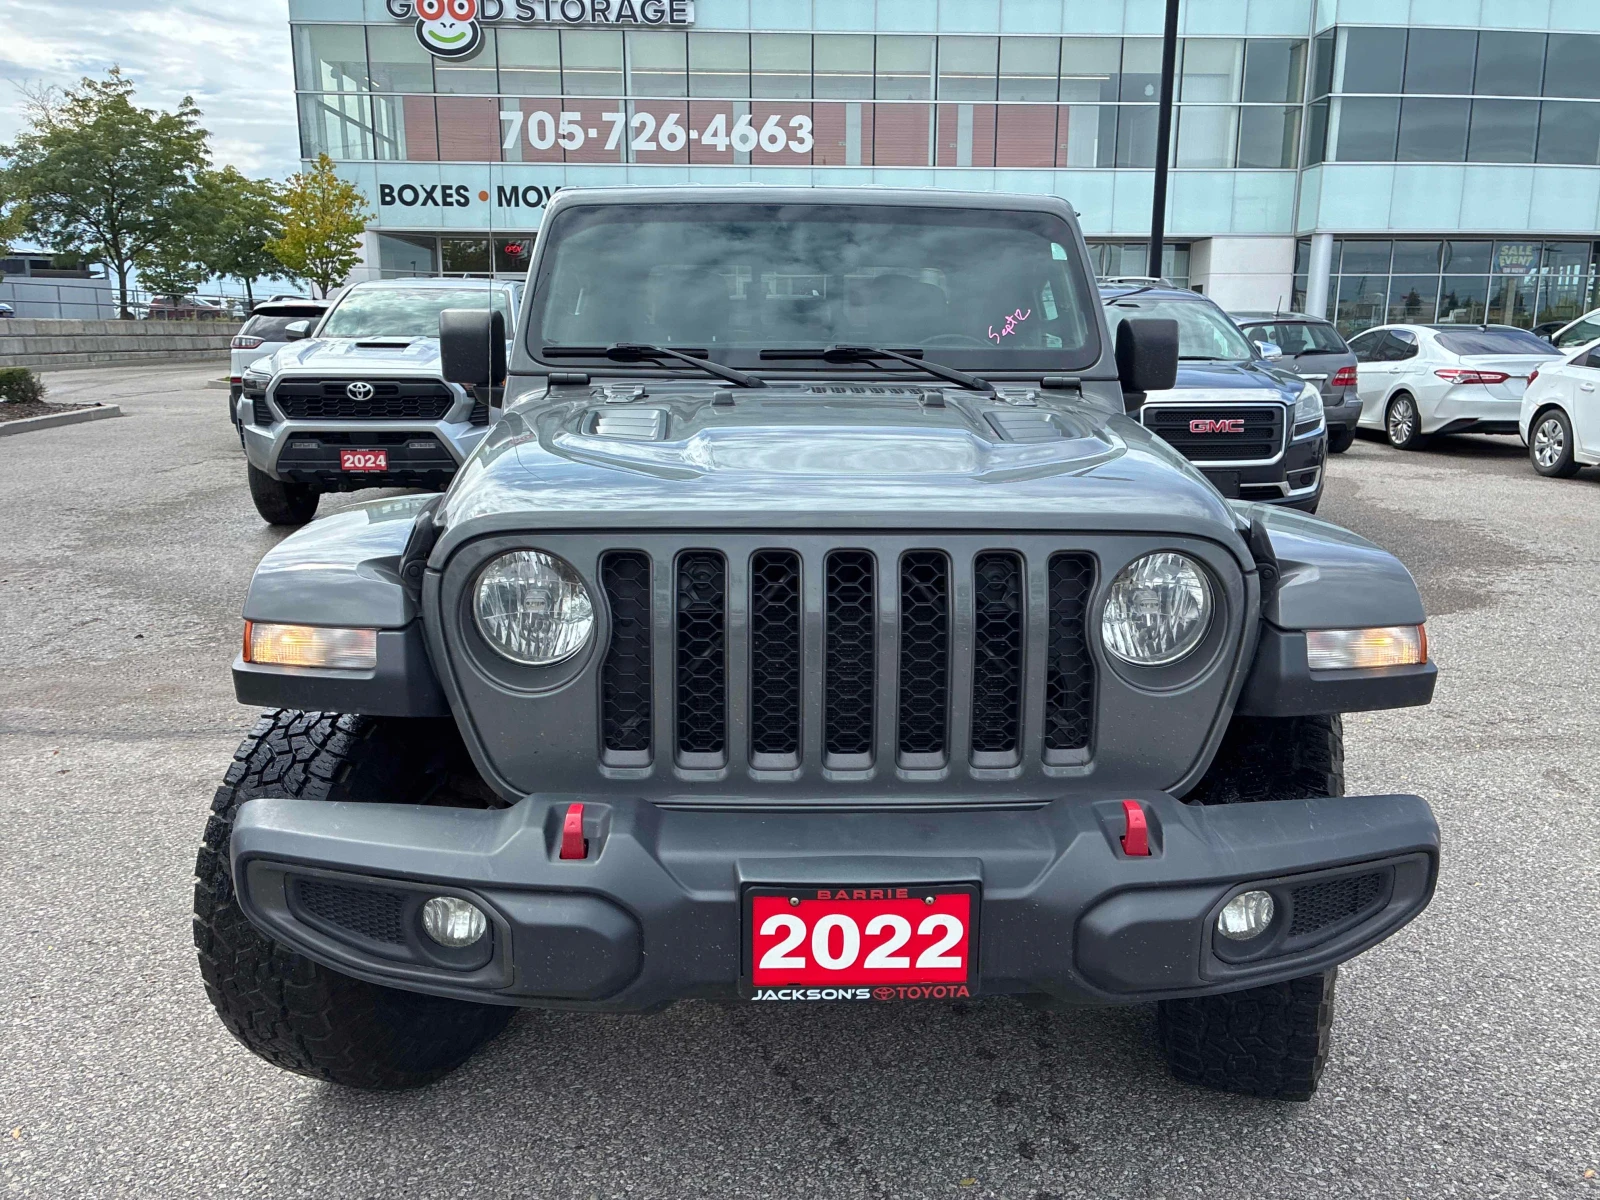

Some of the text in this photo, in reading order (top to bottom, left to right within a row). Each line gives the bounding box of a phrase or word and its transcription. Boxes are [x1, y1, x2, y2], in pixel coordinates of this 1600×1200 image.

[386, 0, 688, 24] GOOD STORAGE
[379, 184, 470, 207] BOXES
[1500, 245, 1532, 255] SALE
[1499, 255, 1533, 267] EVENT
[1189, 419, 1245, 433] GMC
[343, 454, 387, 467] 2024
[817, 889, 909, 900] BARRIE
[759, 914, 964, 970] 2022
[751, 985, 970, 1001] JACKSON'S TOYOTA
